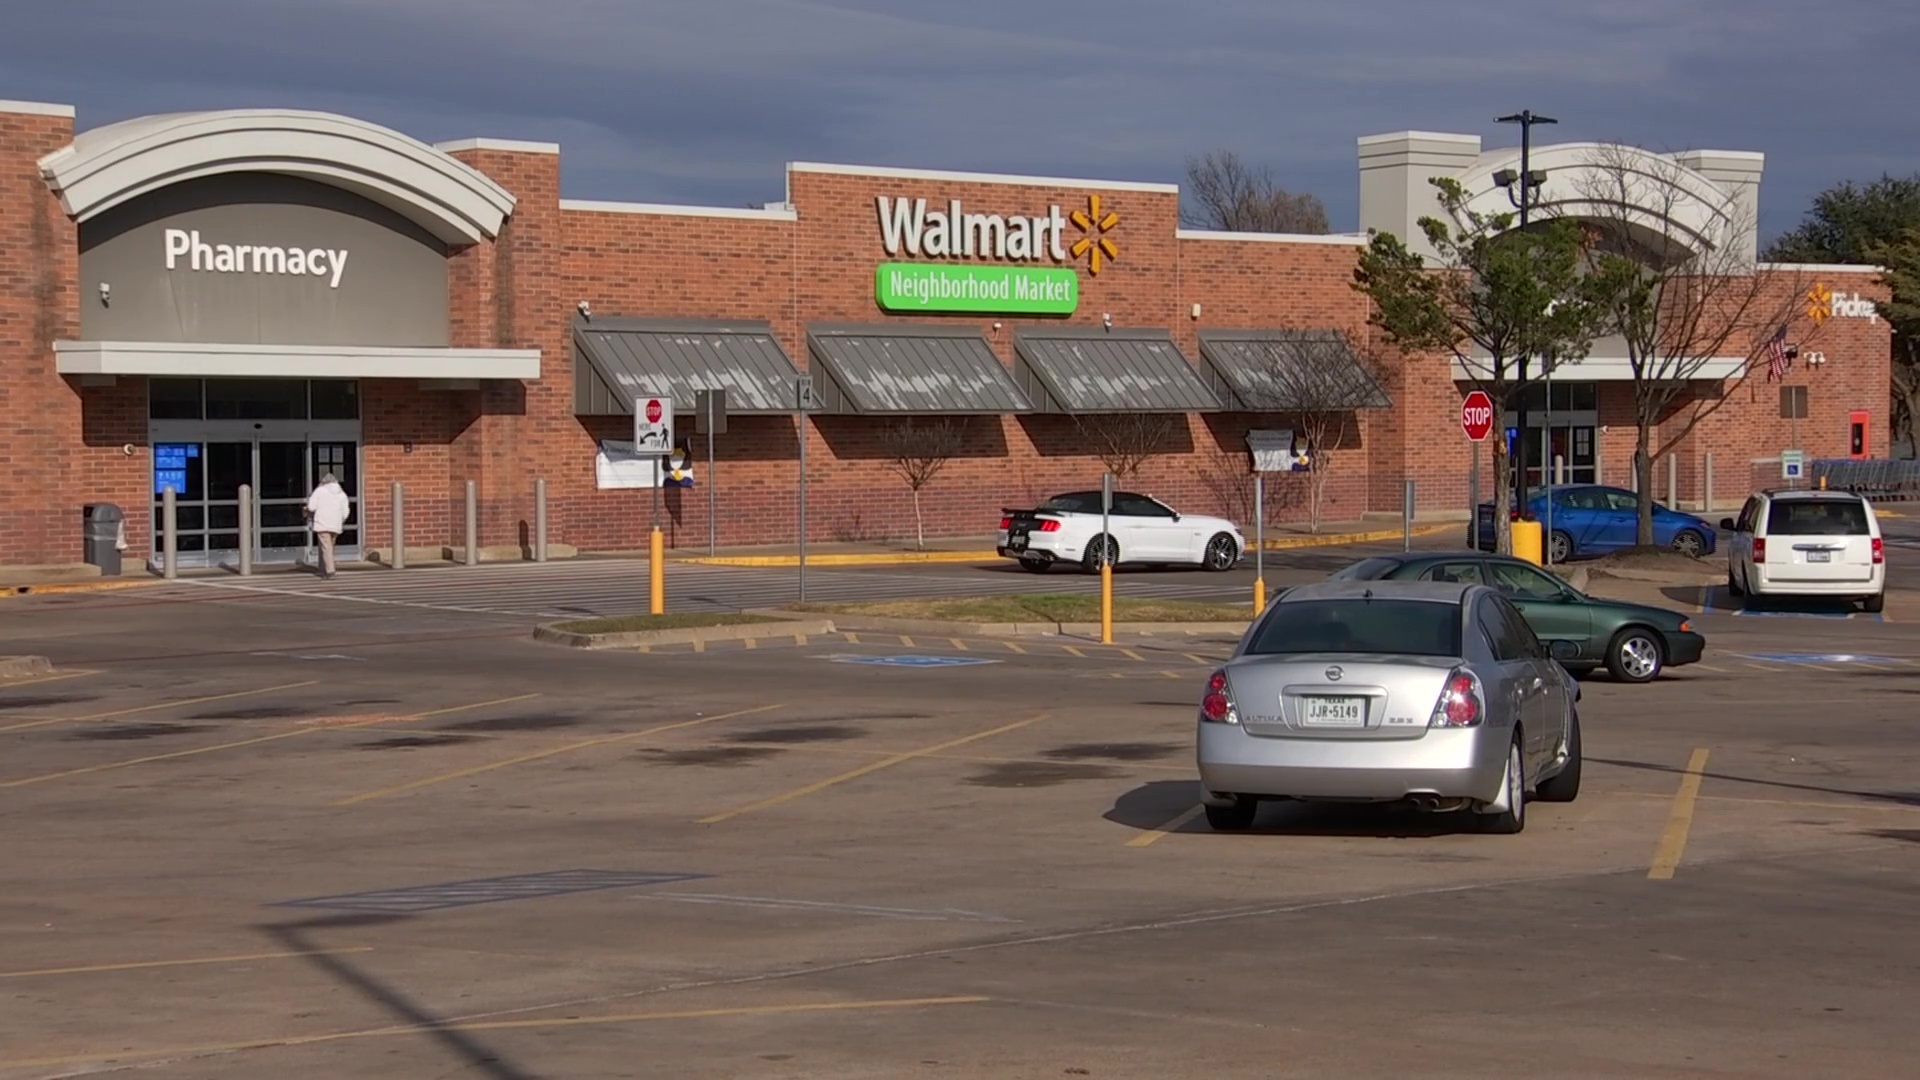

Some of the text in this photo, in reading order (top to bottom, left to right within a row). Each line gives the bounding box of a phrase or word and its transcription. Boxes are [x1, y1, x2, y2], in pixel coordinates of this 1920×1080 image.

[876, 195, 1066, 261] Walmart
[165, 229, 348, 288] Pharmacy
[890, 271, 1071, 304] Neighborhood Market
[647, 406, 662, 416] STOP
[1463, 407, 1490, 426] STOP
